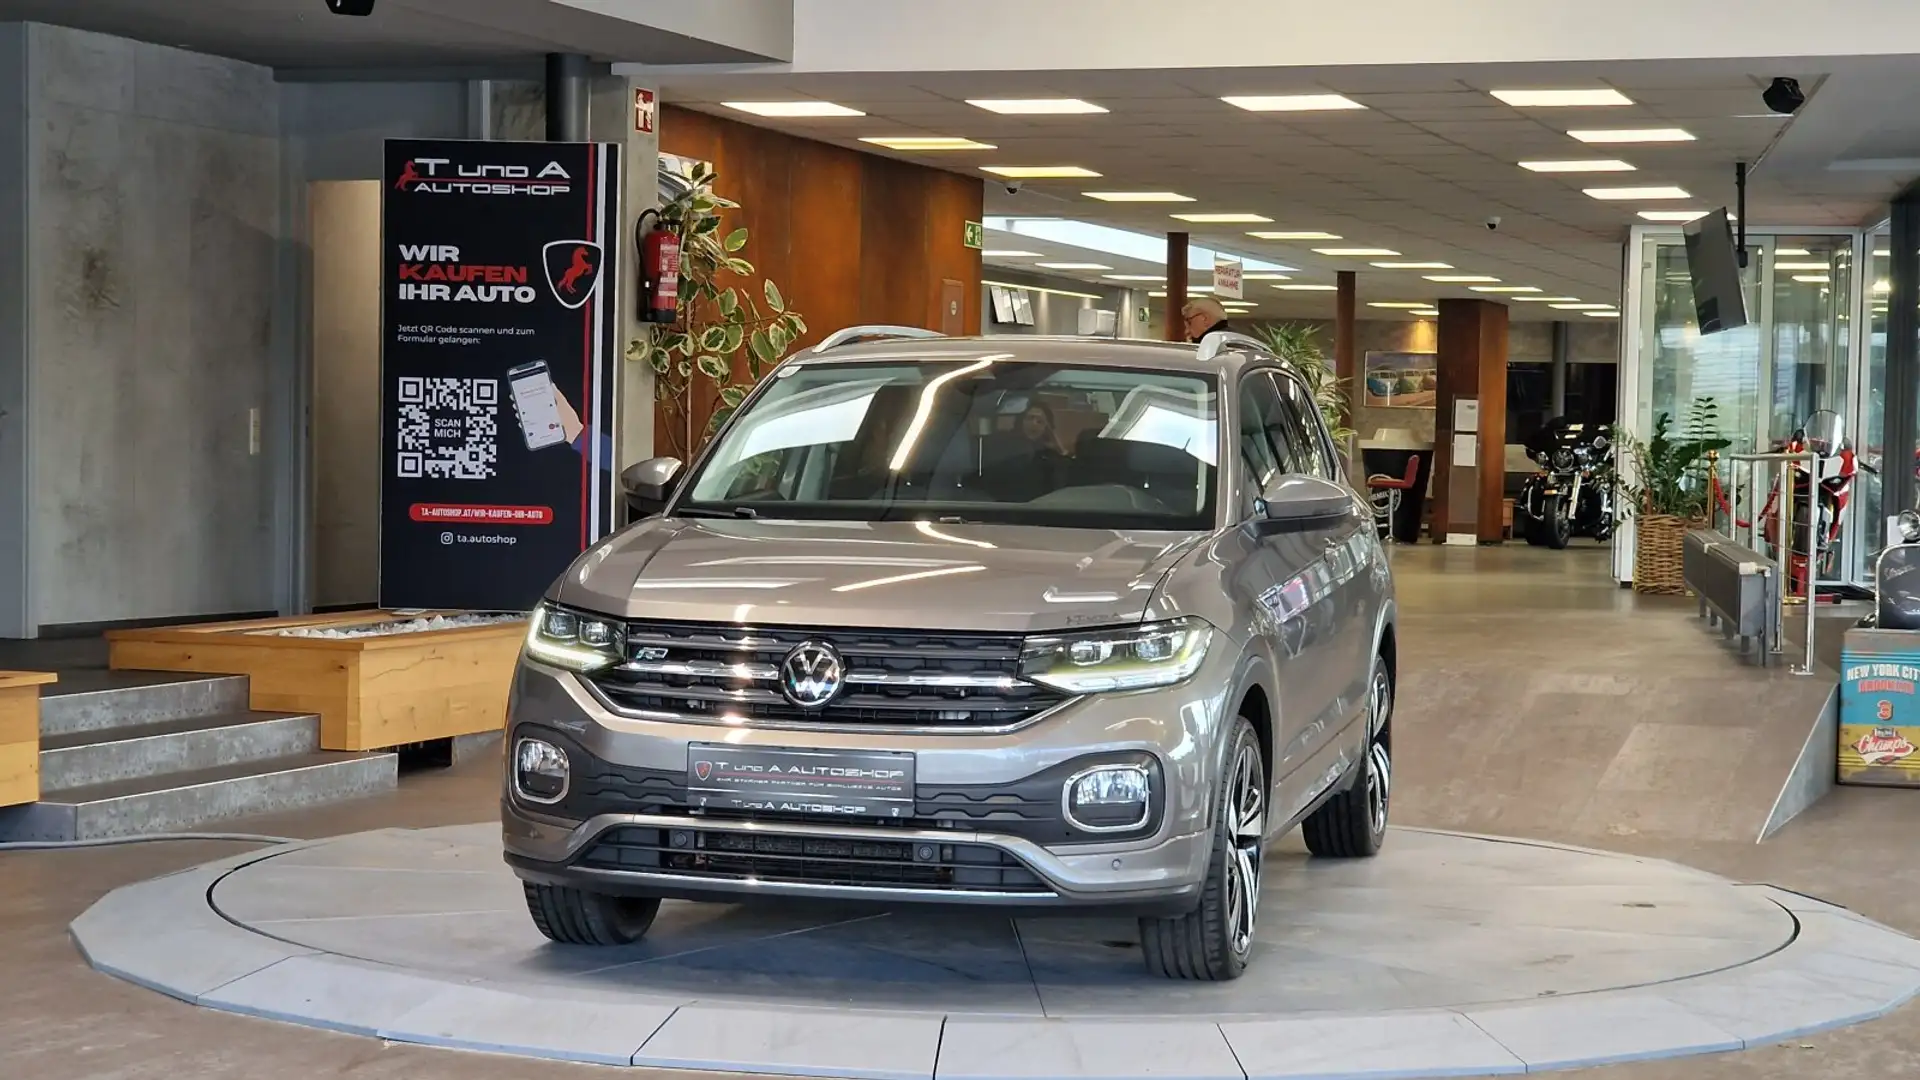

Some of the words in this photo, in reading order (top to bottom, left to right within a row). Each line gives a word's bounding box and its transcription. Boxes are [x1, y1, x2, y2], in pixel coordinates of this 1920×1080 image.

[414, 158, 450, 176] T
[535, 161, 571, 179] A
[413, 182, 571, 196] AUTOSHOP
[398, 244, 460, 262] WIR
[398, 263, 528, 283] KAUFEN
[398, 283, 451, 301] IHR
[453, 284, 537, 304] AUTO
[397, 324, 419, 333] Jetzt
[420, 325, 434, 334] QR
[435, 325, 457, 334] Code
[459, 326, 495, 335] scannen
[496, 327, 514, 336] und
[397, 334, 436, 343] Formular
[438, 335, 482, 346] gelangen:
[434, 418, 462, 428] SCAN
[434, 428, 462, 438] MICH
[457, 533, 518, 546] ta.autoshop
[1847, 665, 1870, 681] NEW
[1872, 663, 1900, 677] YORK
[1902, 664, 1920, 681] CIT
[1876, 700, 1894, 720] 3
[715, 761, 730, 770] T
[768, 764, 783, 774] A
[787, 766, 905, 779] AUTOSHOP
[764, 801, 777, 810] A
[779, 802, 867, 814] AUTOSHOP
